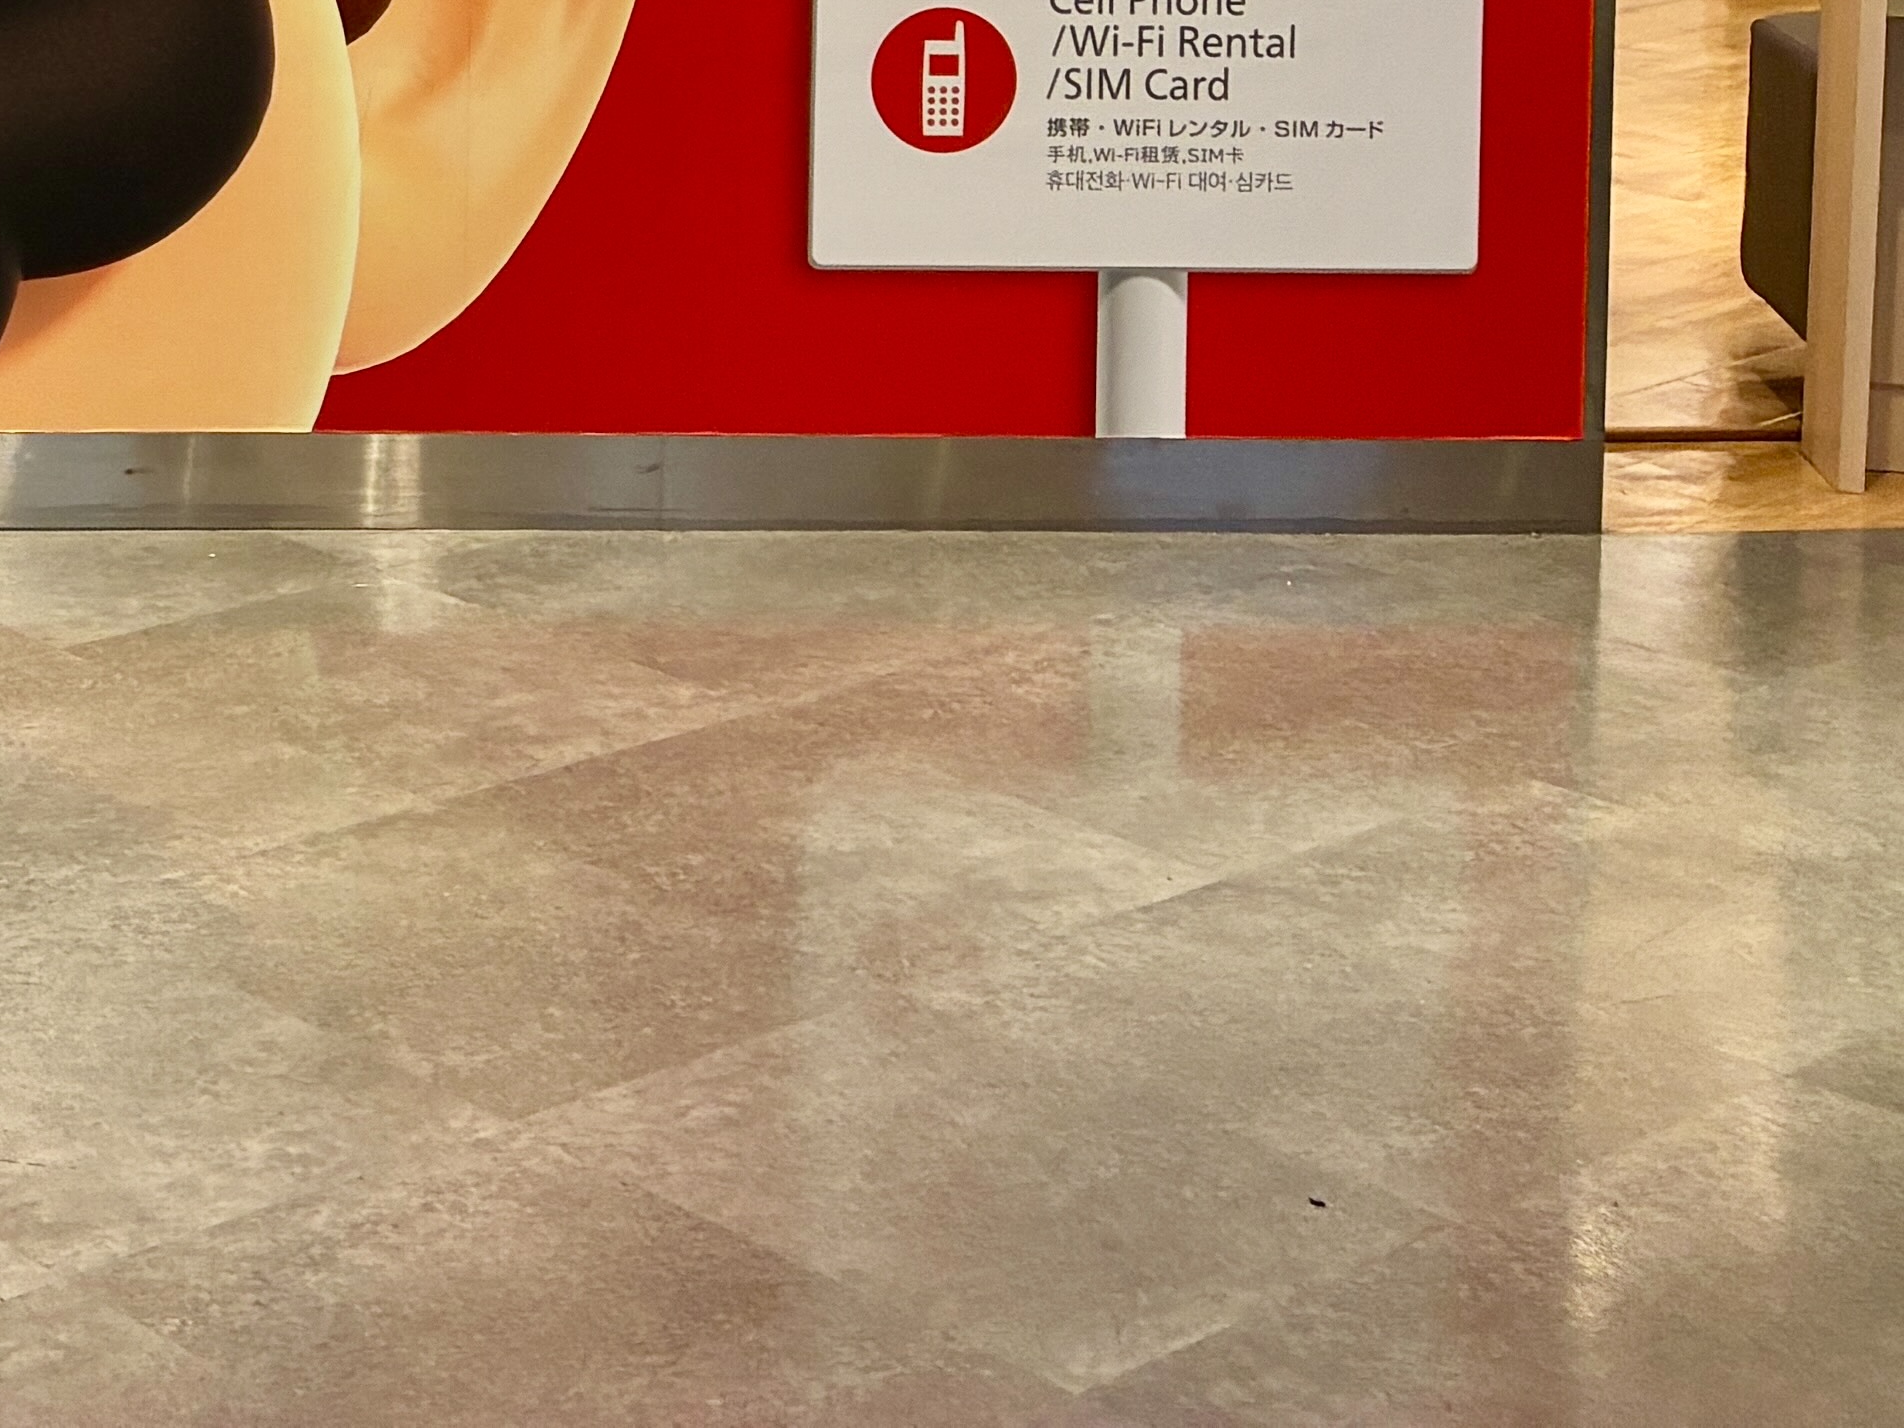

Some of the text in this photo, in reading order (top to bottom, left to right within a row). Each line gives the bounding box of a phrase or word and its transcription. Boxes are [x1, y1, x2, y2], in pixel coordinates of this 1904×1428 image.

[1052, 23, 1296, 59] /Wi-Fi Rental
[1046, 66, 1230, 102] /SIM Card
[1325, 120, 1384, 140] カード
